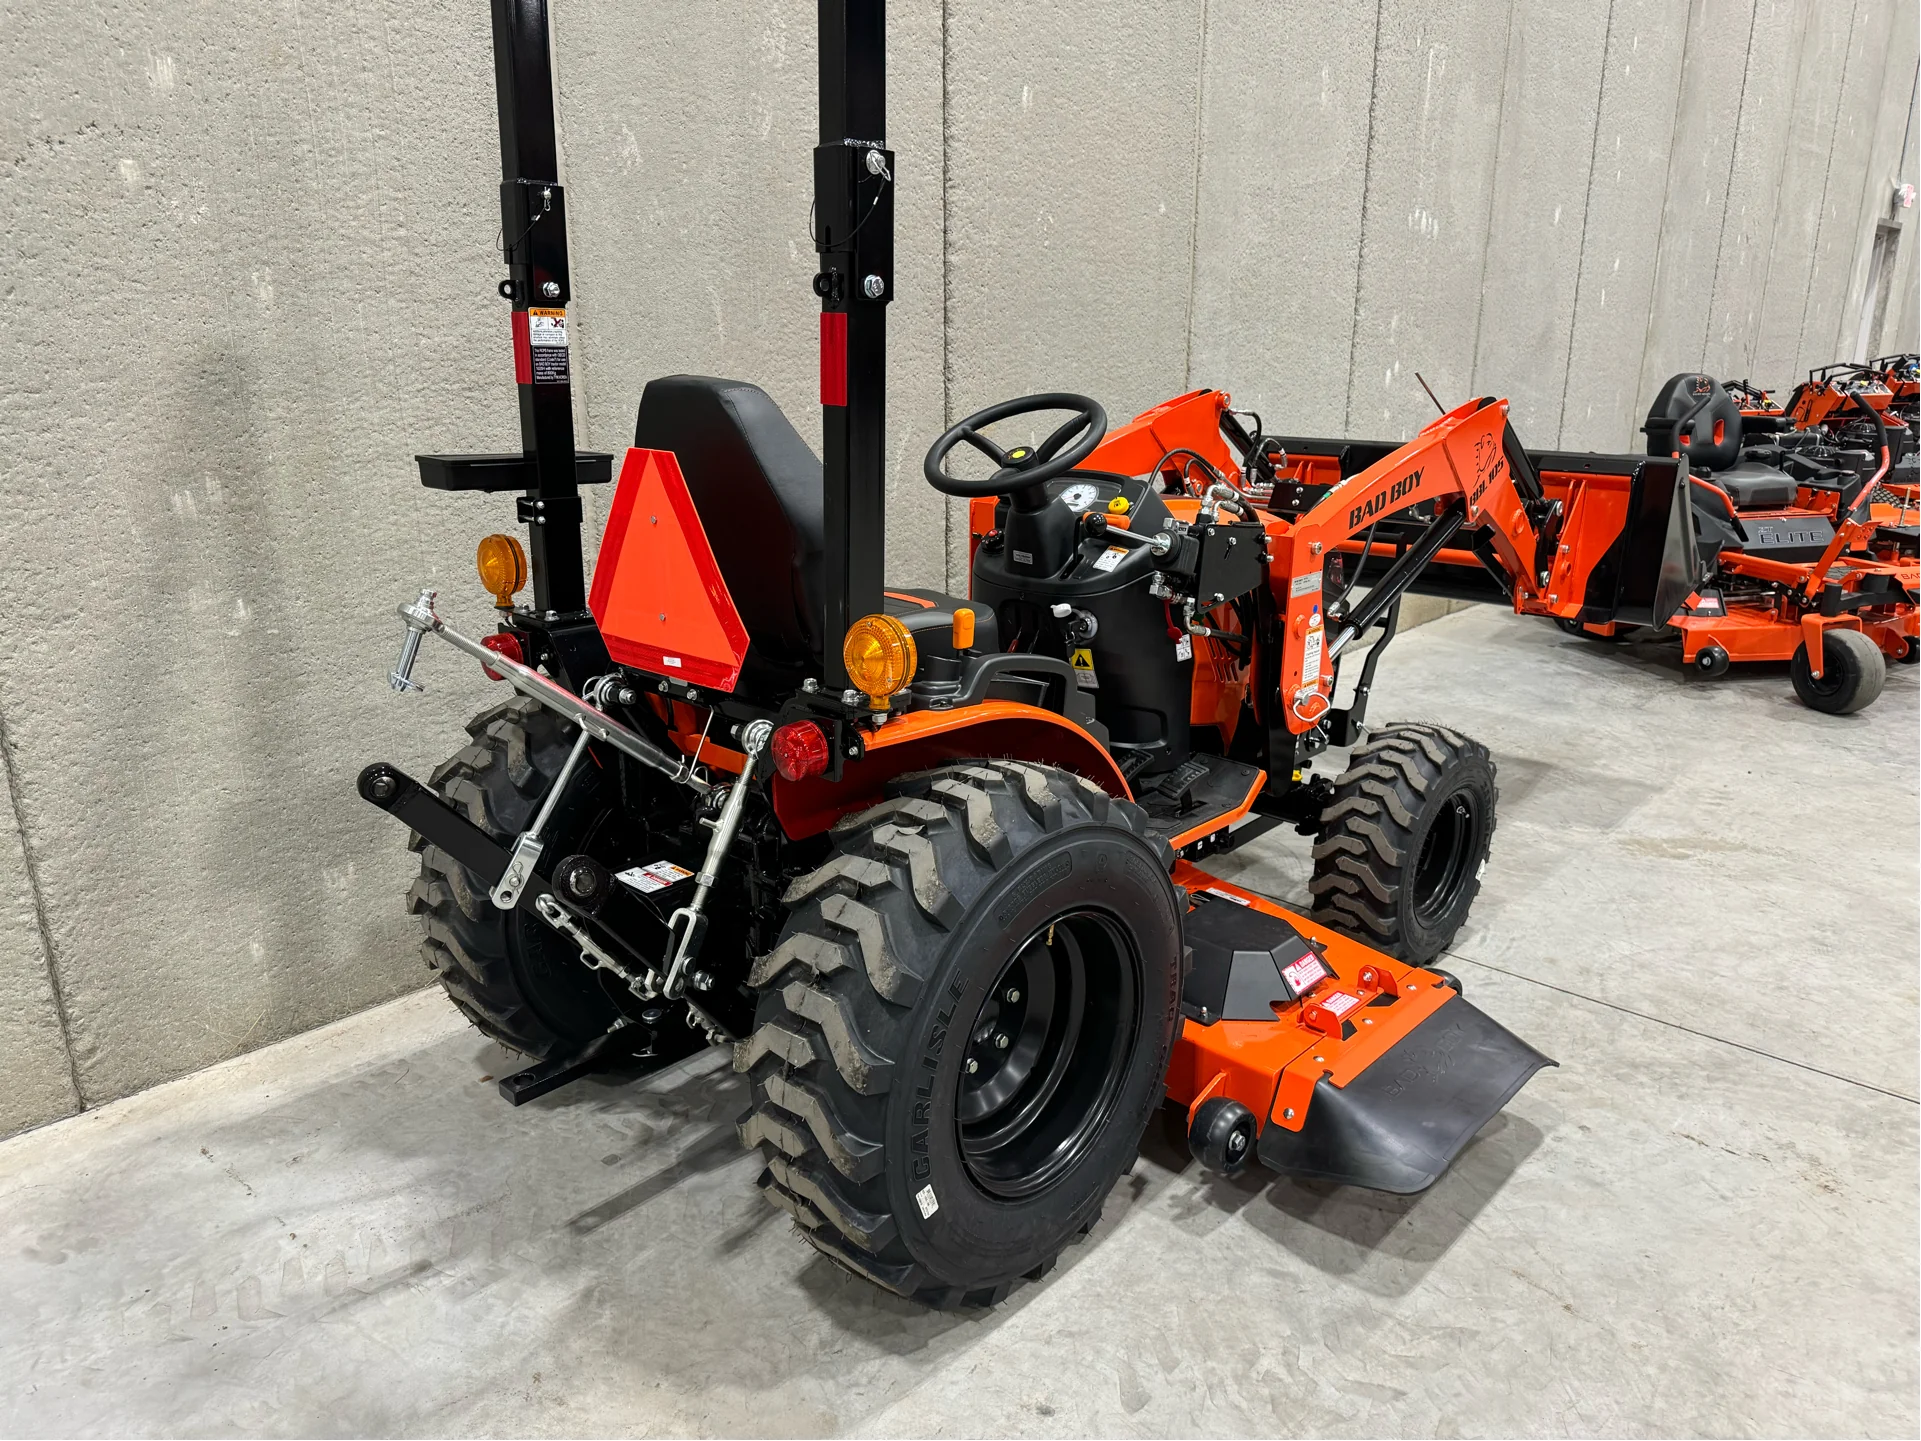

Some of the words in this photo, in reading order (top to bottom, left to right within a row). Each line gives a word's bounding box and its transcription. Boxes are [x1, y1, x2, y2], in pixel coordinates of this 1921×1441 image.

[1488, 455, 1504, 484] 105
[1349, 490, 1387, 530] BAD
[1390, 466, 1425, 504] BOY
[1759, 531, 1825, 545] ELITE
[911, 967, 969, 1182] CARLISLE
